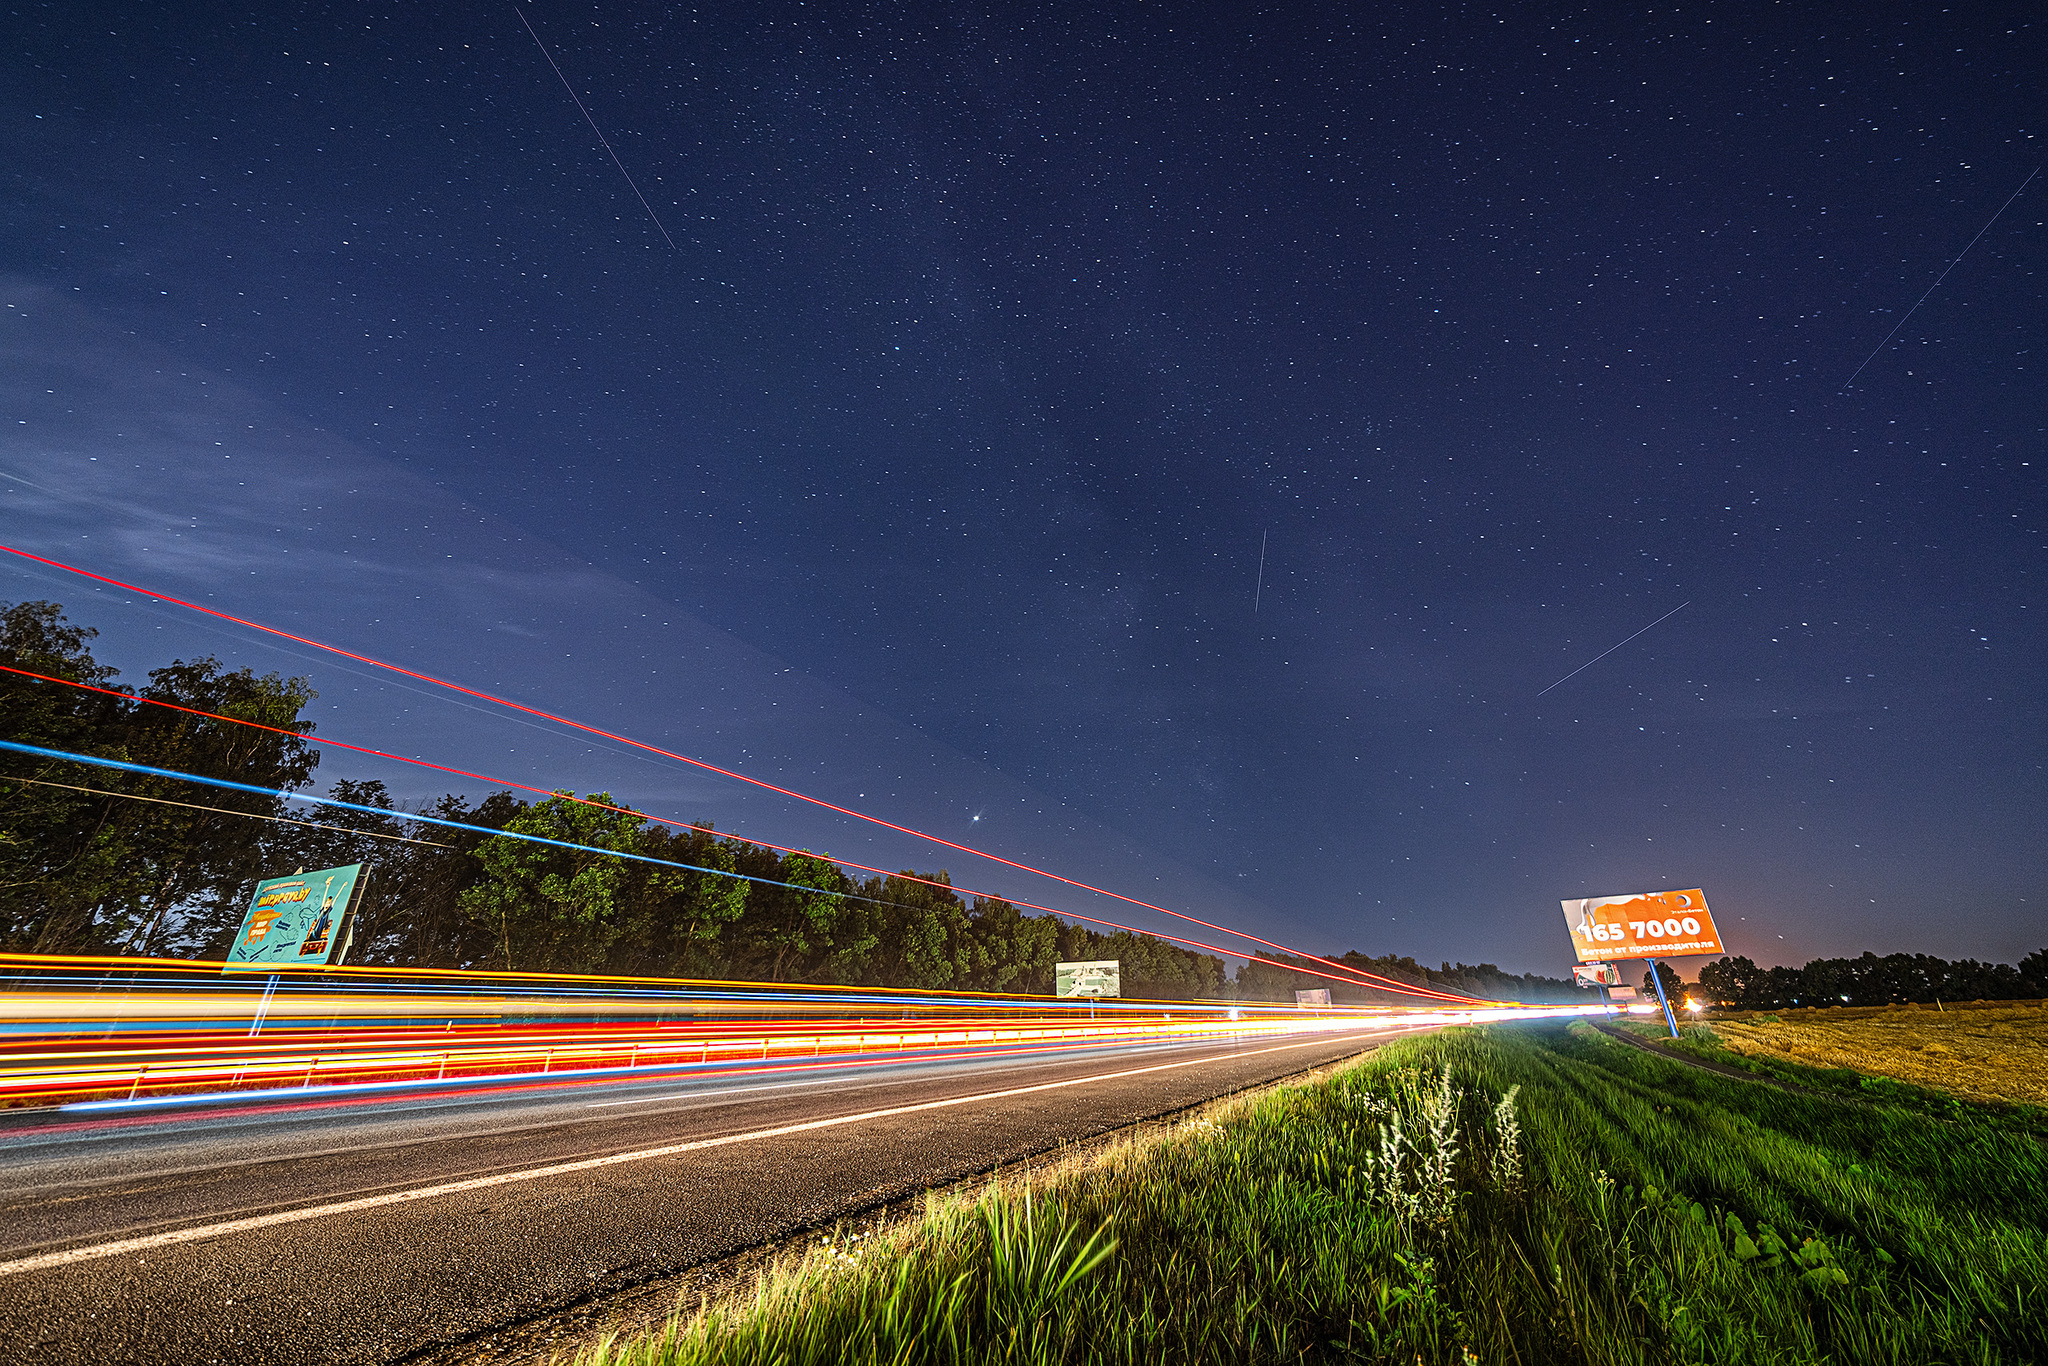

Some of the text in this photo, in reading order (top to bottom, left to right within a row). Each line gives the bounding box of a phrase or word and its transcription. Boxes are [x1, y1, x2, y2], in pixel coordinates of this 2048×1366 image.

[1583, 917, 1701, 943] 165 7000
[1581, 947, 1613, 956] Бетон
[1629, 940, 1715, 954] производителя
